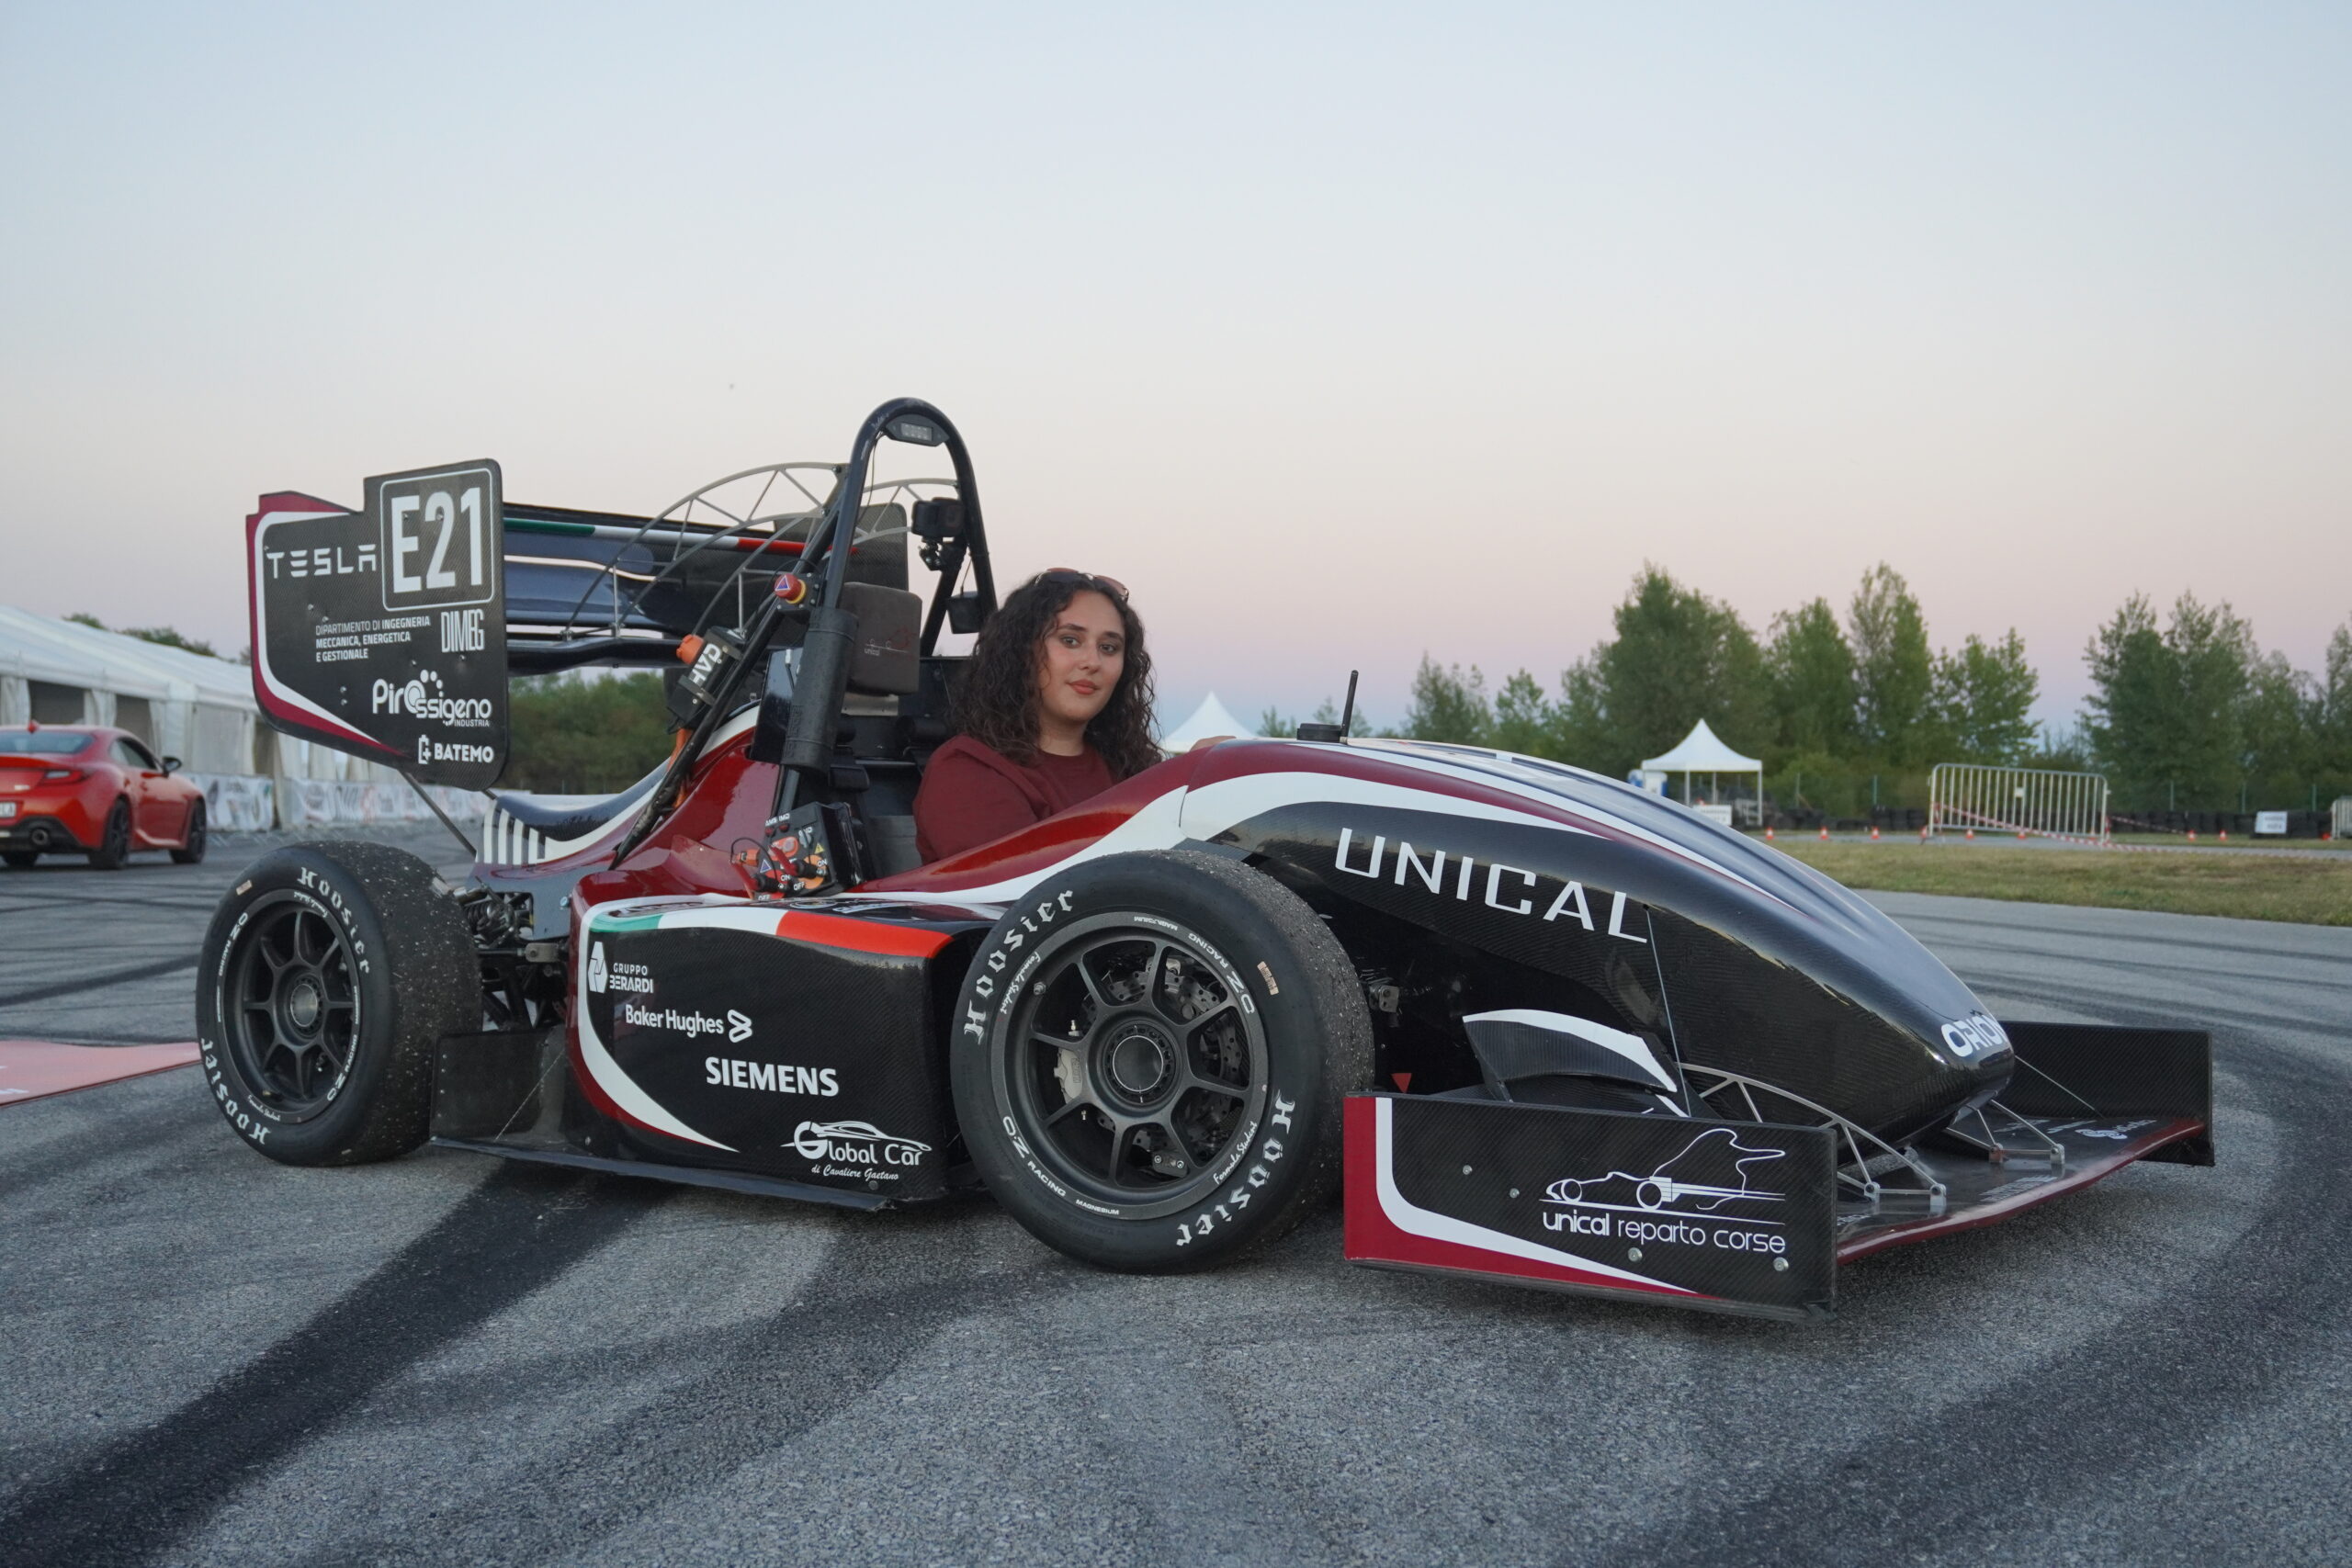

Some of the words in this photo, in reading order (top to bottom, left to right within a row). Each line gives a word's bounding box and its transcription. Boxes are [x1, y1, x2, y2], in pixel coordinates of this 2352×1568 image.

[390, 487, 483, 593] E21
[266, 544, 377, 579] TESLA
[315, 620, 371, 636] DIPARTIMENTO
[372, 620, 380, 631] DI
[381, 615, 431, 630] INGEGNERIA
[363, 631, 412, 645] ENERGETICA
[316, 651, 322, 662] E
[322, 648, 369, 661] GESTIONALE
[691, 643, 721, 684] HVD
[454, 719, 490, 728] INDUSTRIA
[434, 742, 495, 764] BATEMO
[780, 874, 790, 882] ON
[817, 859, 827, 867] ON
[793, 881, 805, 891] OFF
[1335, 827, 1648, 944] UNICAL
[298, 867, 370, 974] Hoosier
[964, 889, 1074, 1045] Hoosier
[1188, 932, 1229, 969] RACING
[609, 975, 654, 994] BERARDI
[613, 962, 648, 976] GRUPPO
[625, 1004, 663, 1028] Baker
[665, 1009, 724, 1038] Hughes
[201, 1037, 272, 1145] Hoosier
[705, 1056, 840, 1097] SIEMENS
[794, 1121, 878, 1164] Global
[885, 1143, 922, 1166] Car
[811, 1164, 820, 1174] di
[822, 1164, 861, 1178] Cavaliere
[864, 1168, 899, 1182] Gaetano
[1176, 1089, 1295, 1247] Hoosier
[1027, 1160, 1067, 1197] RACING
[1076, 1199, 1119, 1215] MAGNESIUM
[1543, 1209, 1610, 1236] unical
[1618, 1218, 1706, 1246] reparto
[1713, 1228, 1786, 1254] corse
